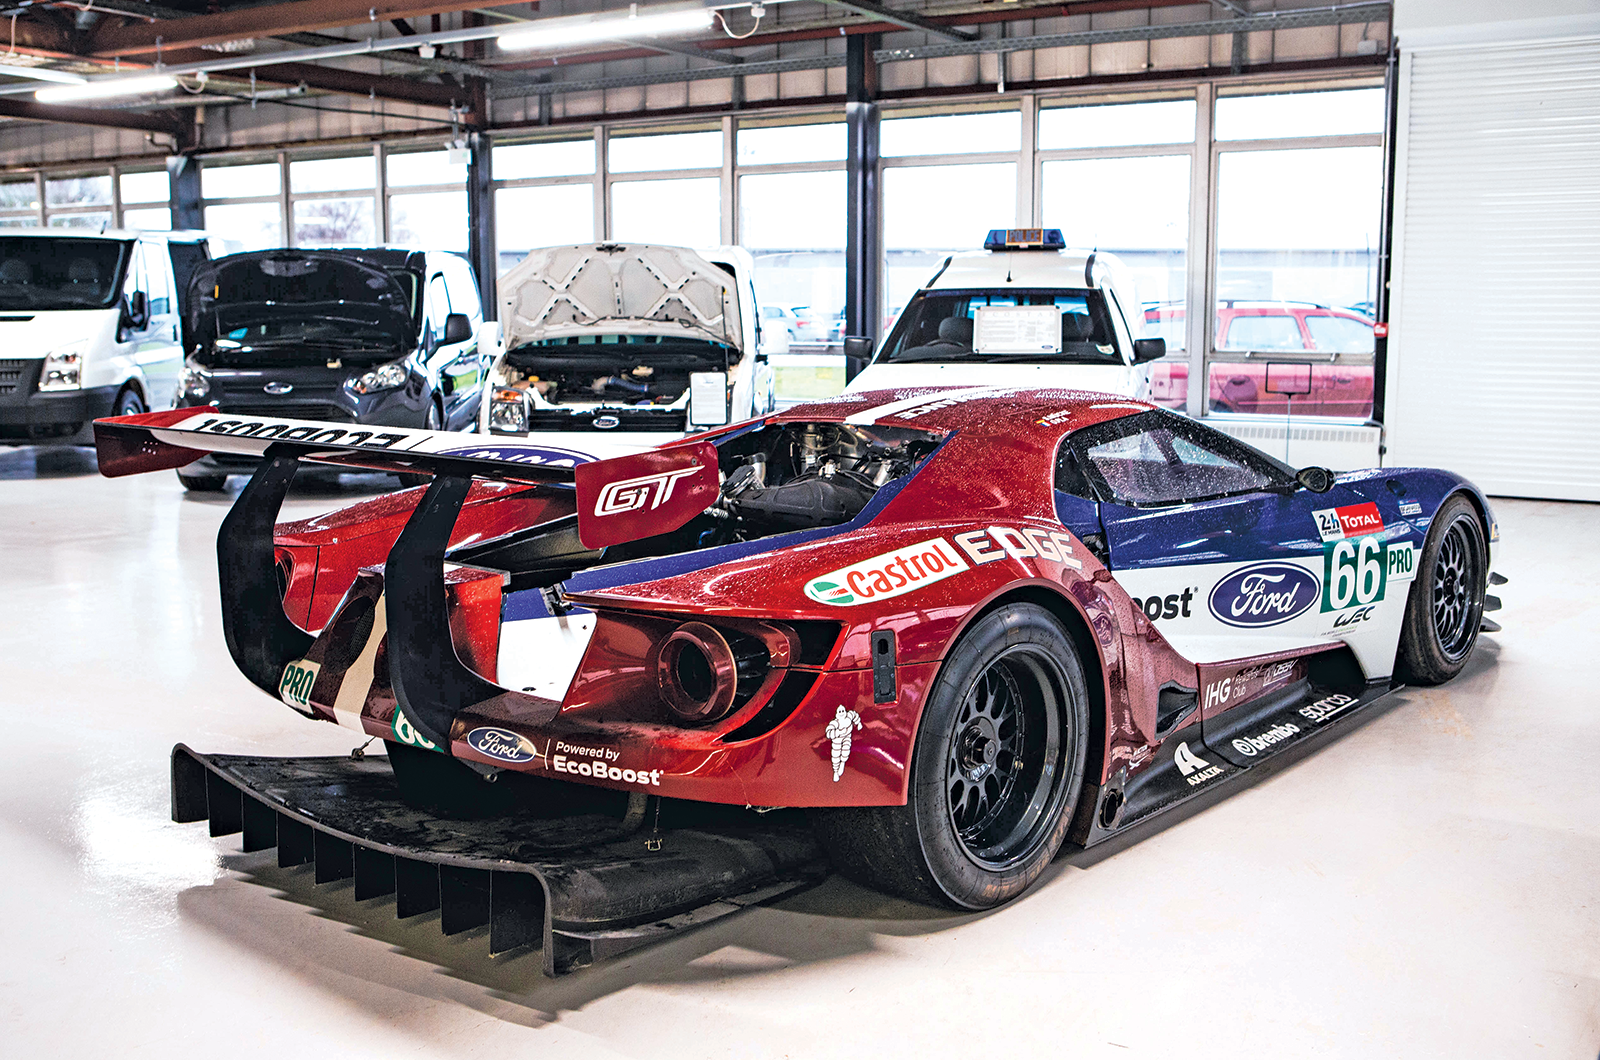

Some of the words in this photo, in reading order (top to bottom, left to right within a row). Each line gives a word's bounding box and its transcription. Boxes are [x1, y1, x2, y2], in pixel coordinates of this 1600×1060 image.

[594, 465, 705, 516] GT
[846, 544, 958, 598] Castrol
[953, 526, 1083, 569] EDGE
[1330, 537, 1381, 609] 66
[1389, 547, 1412, 575] PRO
[1230, 573, 1300, 617] Ford
[1333, 605, 1375, 628] WEC
[280, 664, 314, 705] PRO
[1204, 677, 1232, 709] IHG
[1233, 685, 1246, 699] Club
[1299, 694, 1352, 719] sparco
[478, 730, 522, 759] Ford
[1250, 723, 1301, 751] brembo
[556, 741, 602, 758] Powered
[605, 748, 620, 762] by
[1186, 765, 1224, 786] AXALTA
